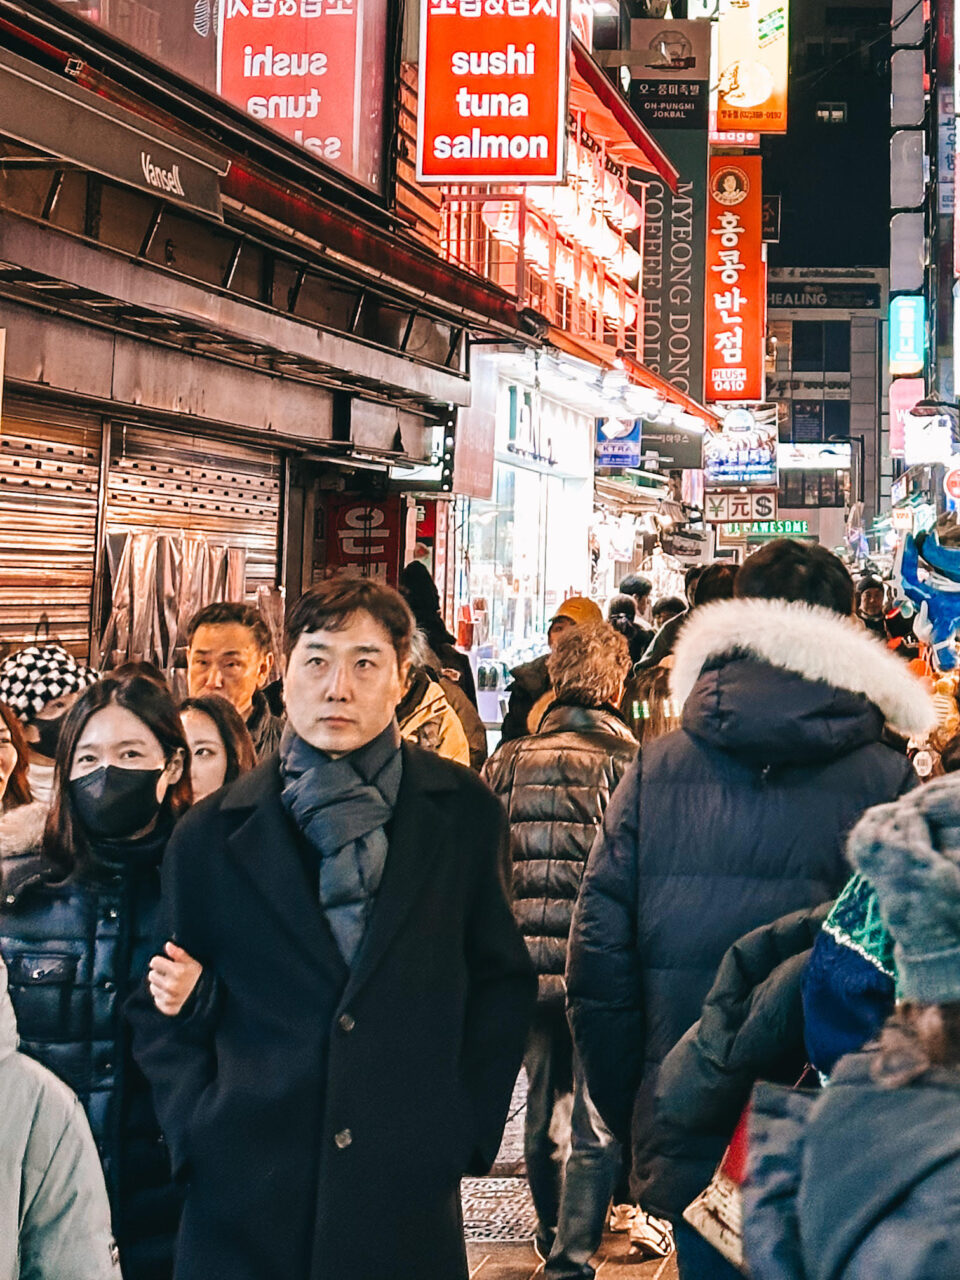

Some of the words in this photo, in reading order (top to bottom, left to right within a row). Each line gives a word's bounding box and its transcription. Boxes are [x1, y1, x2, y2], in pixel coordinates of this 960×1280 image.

[451, 44, 535, 75] sushi
[456, 87, 528, 118] tuna
[653, 110, 686, 118] JOKBAL
[433, 128, 548, 159] salmon
[141, 151, 185, 196] Vansell
[669, 181, 694, 306] MYEONG
[711, 211, 748, 364] 홍콩반점
[714, 381, 745, 391] 0410
[708, 497, 725, 517] ¥
[731, 496, 750, 517] 元
[755, 495, 773, 517] $
[752, 521, 808, 533] AWESOME
